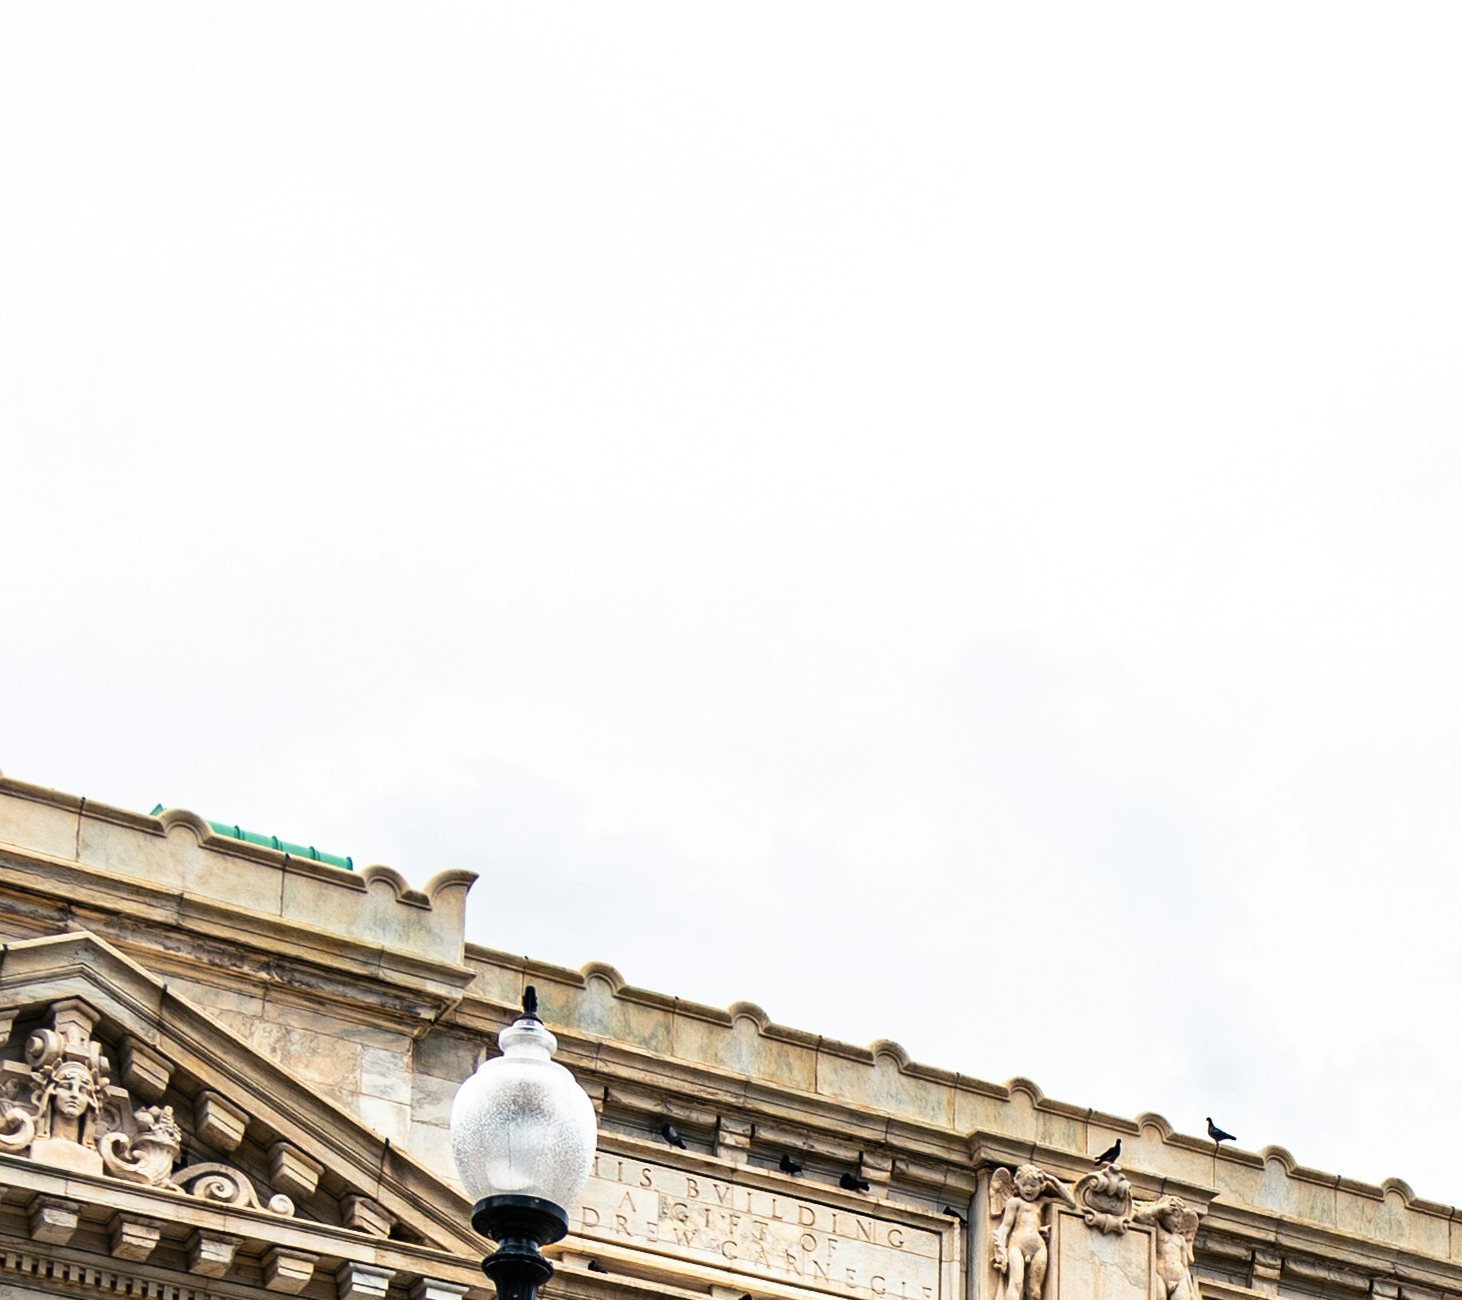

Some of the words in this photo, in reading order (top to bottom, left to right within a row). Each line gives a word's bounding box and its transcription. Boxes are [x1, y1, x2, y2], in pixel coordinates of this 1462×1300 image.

[618, 1191, 637, 1213] A
[671, 1202, 769, 1241] GIFT
[799, 1232, 839, 1259] OF
[685, 1176, 905, 1249] BVILDING
